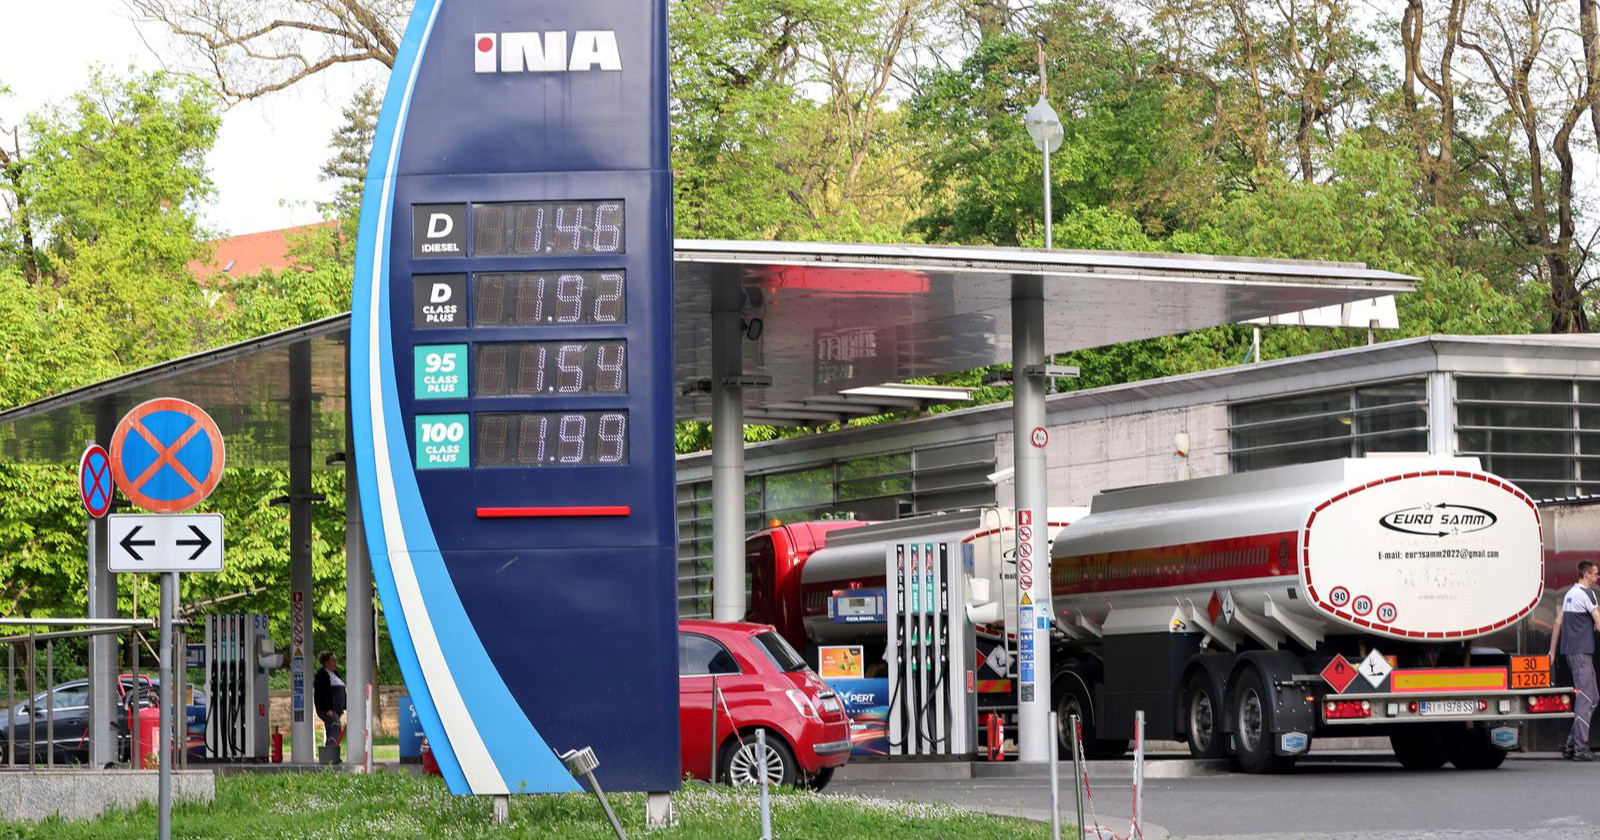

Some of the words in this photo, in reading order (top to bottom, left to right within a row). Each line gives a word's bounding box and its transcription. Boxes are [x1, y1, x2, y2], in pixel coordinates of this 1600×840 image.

[475, 30, 622, 72] INA
[427, 213, 454, 239] D
[430, 283, 452, 303] D
[535, 274, 623, 322] 1.92
[422, 305, 458, 314] CLASS
[426, 313, 454, 323] PLUS
[425, 352, 457, 373] 95
[536, 345, 625, 393] 1.54
[424, 375, 458, 384] CLASS
[427, 383, 455, 393] PLUS
[421, 422, 464, 443] 100
[537, 414, 626, 463] 1.99
[425, 445, 460, 454] CLASS
[429, 453, 457, 462] PLUS
[1393, 514, 1434, 524] EURO
[1440, 514, 1485, 525] SAMM
[1334, 592, 1346, 601] 90
[1357, 601, 1368, 610] 80
[1382, 608, 1393, 617] 70
[1523, 658, 1537, 670] 30
[1517, 673, 1546, 686] 1202
